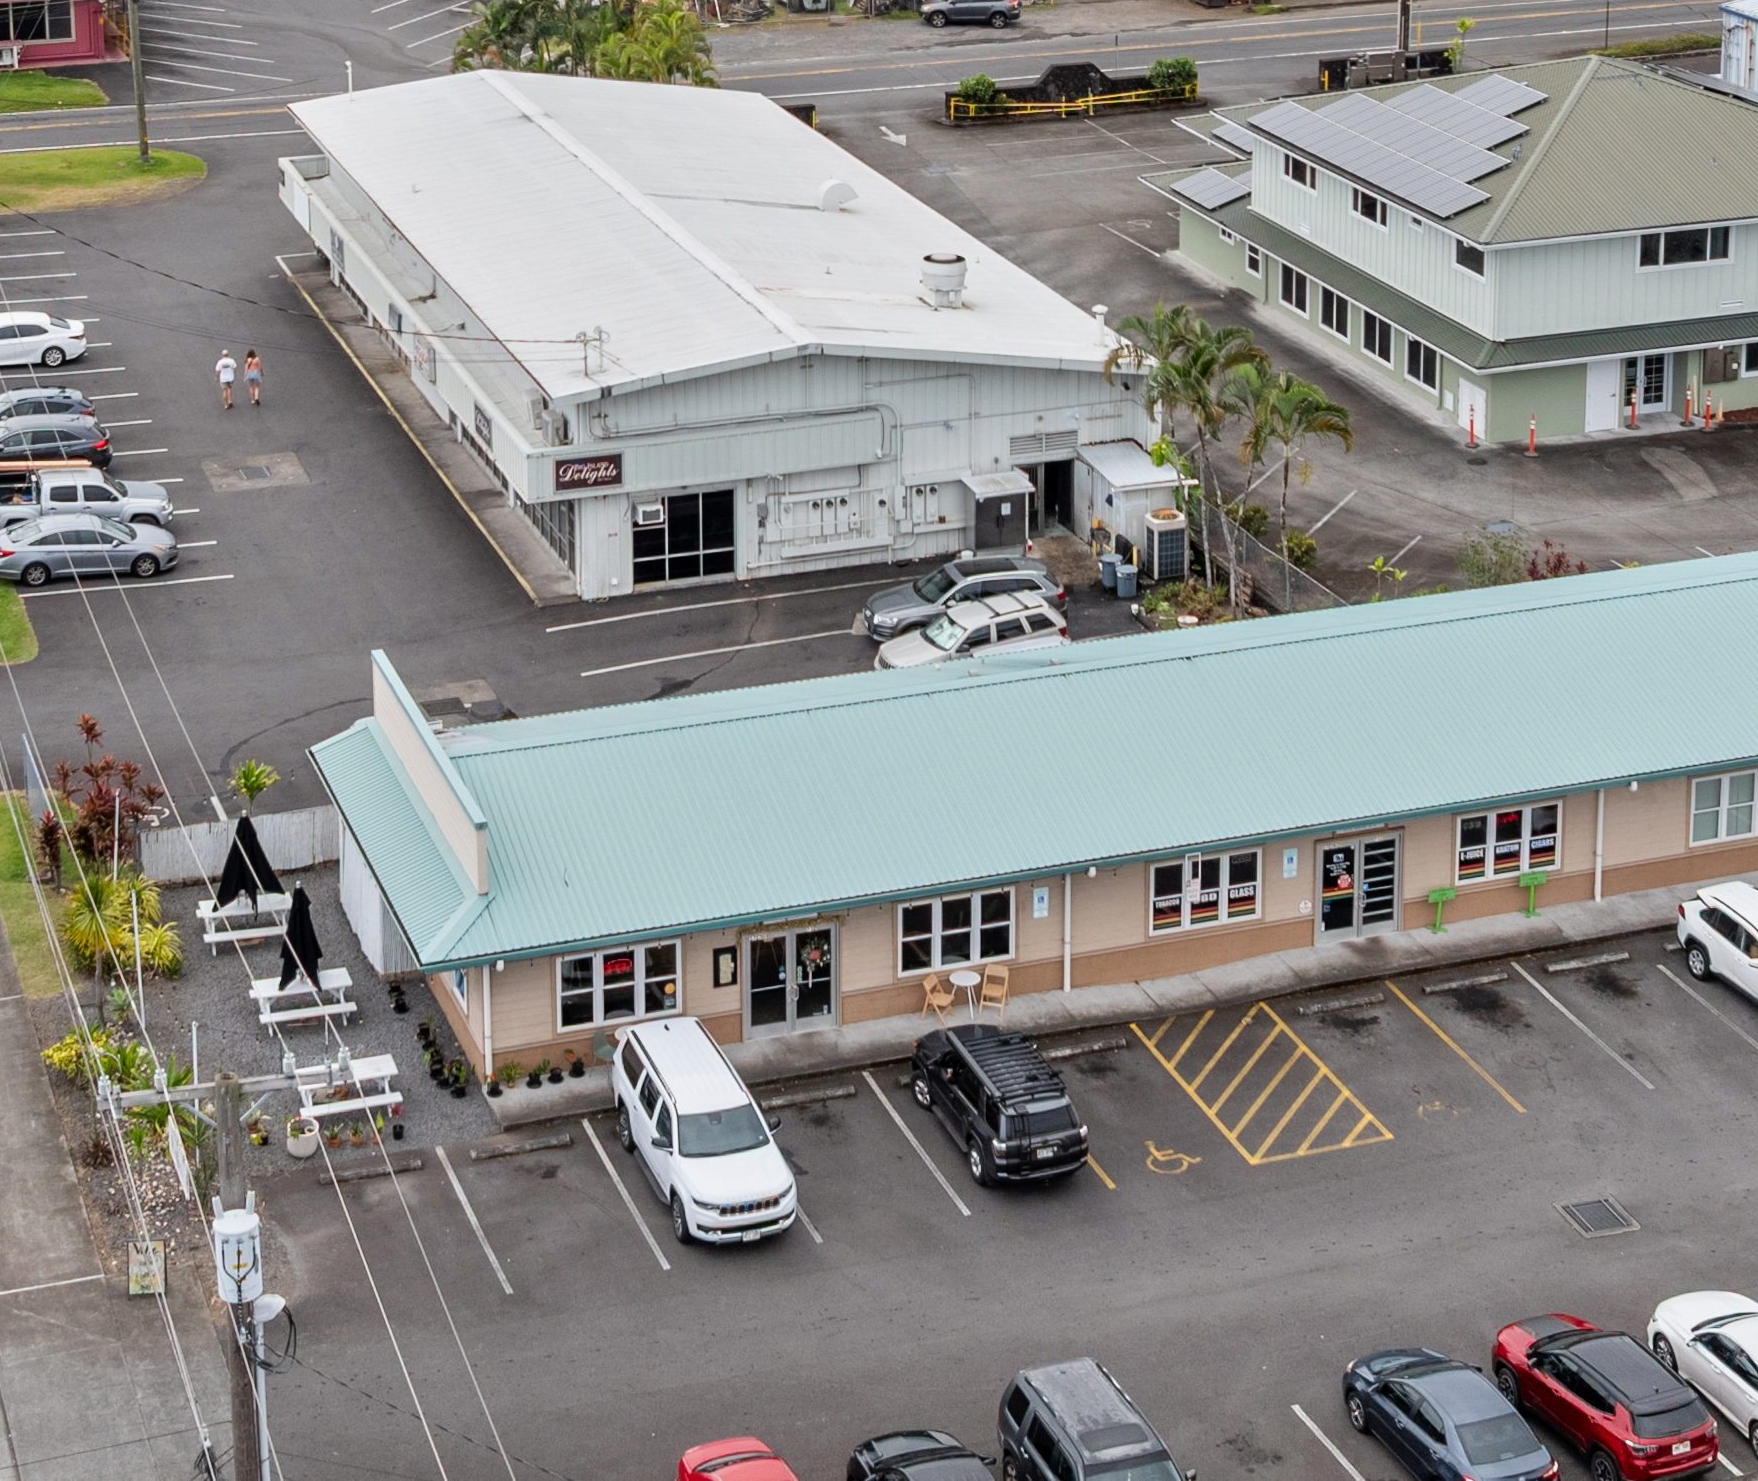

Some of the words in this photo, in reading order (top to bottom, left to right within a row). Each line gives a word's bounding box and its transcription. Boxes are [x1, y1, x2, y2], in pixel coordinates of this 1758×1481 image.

[559, 464, 620, 484] Delights
[1495, 843, 1520, 855] KRATOM
[1530, 838, 1555, 850] CIGARS
[1460, 848, 1485, 861] E-JUICE
[1229, 887, 1255, 900] GLASS
[1155, 898, 1180, 910] TOBACCO
